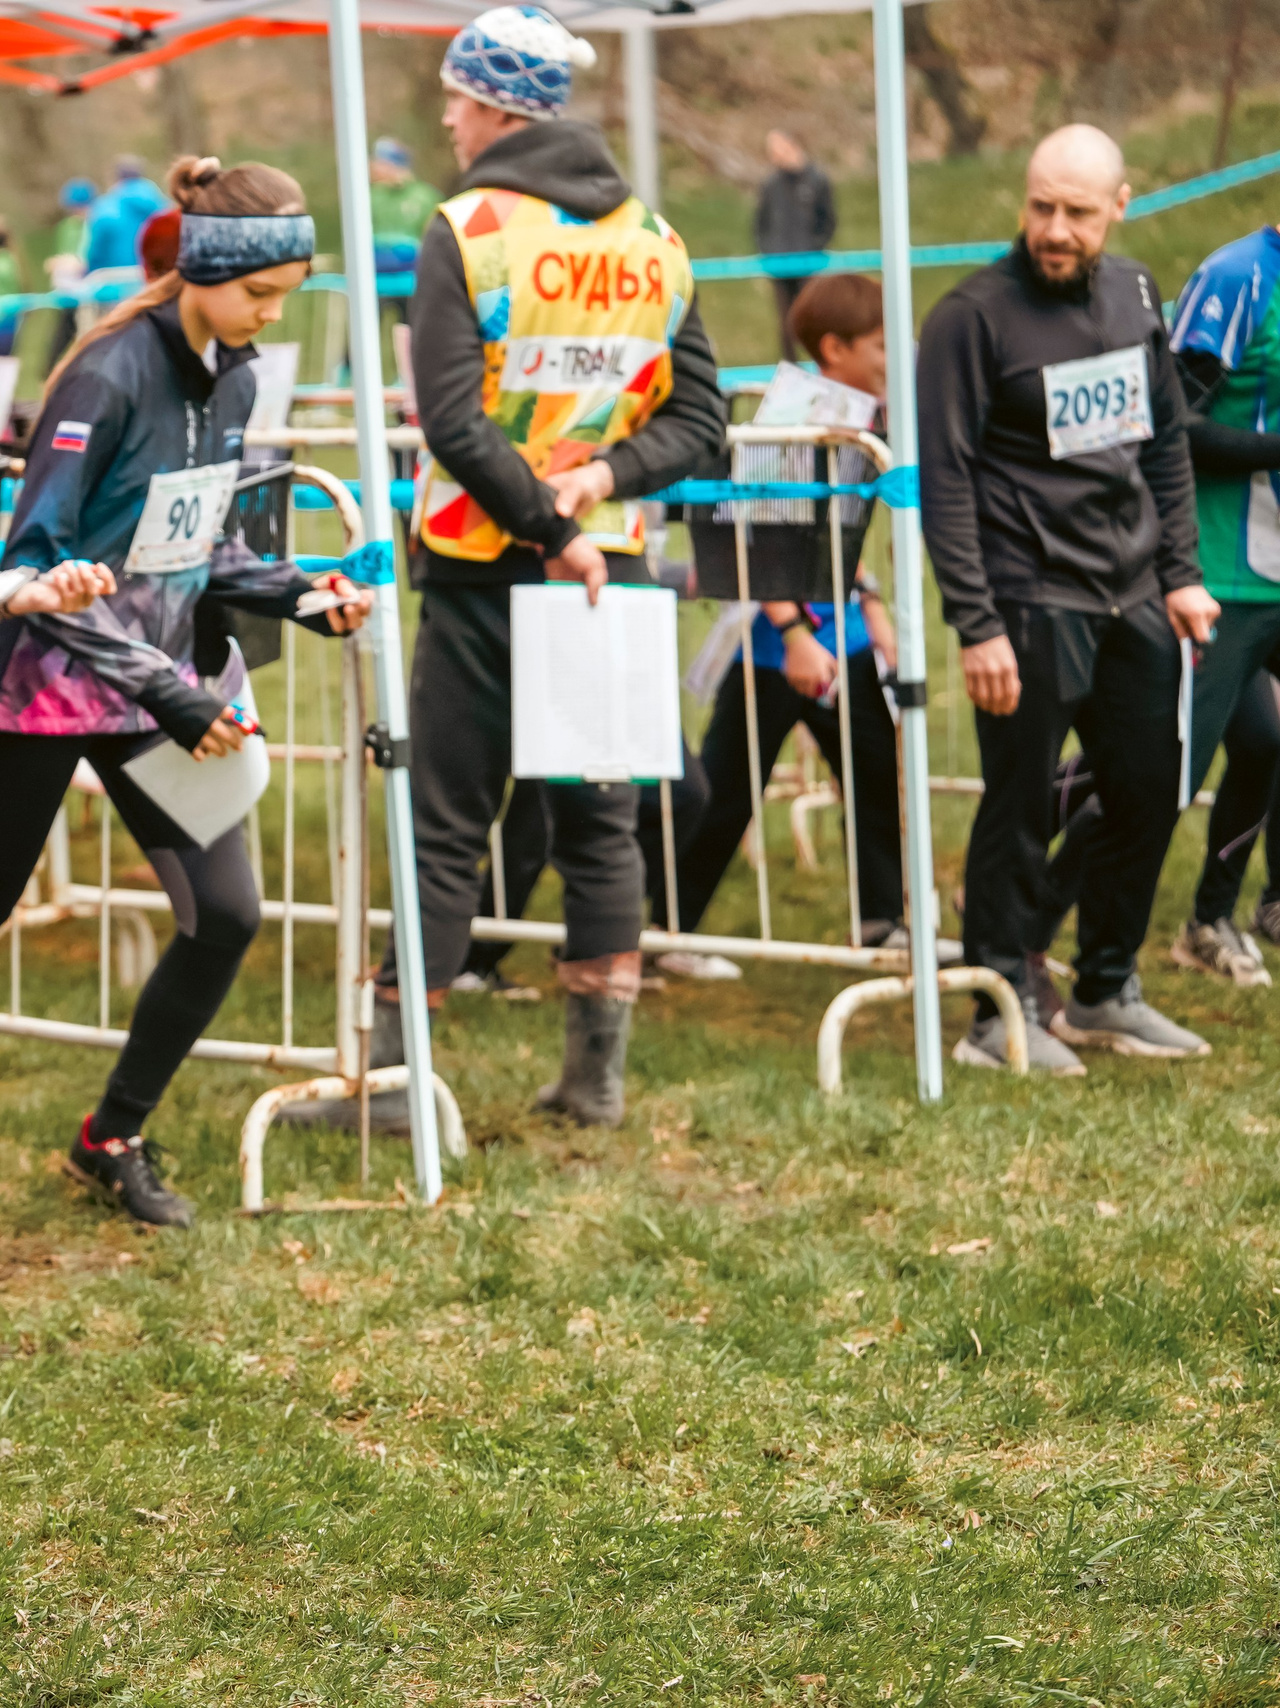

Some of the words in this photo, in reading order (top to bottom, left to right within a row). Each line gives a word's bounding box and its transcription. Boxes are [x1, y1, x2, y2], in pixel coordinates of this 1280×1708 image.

[532, 250, 665, 312] СУДЬЯ
[1052, 377, 1126, 429] 2093
[166, 495, 201, 541] 90
